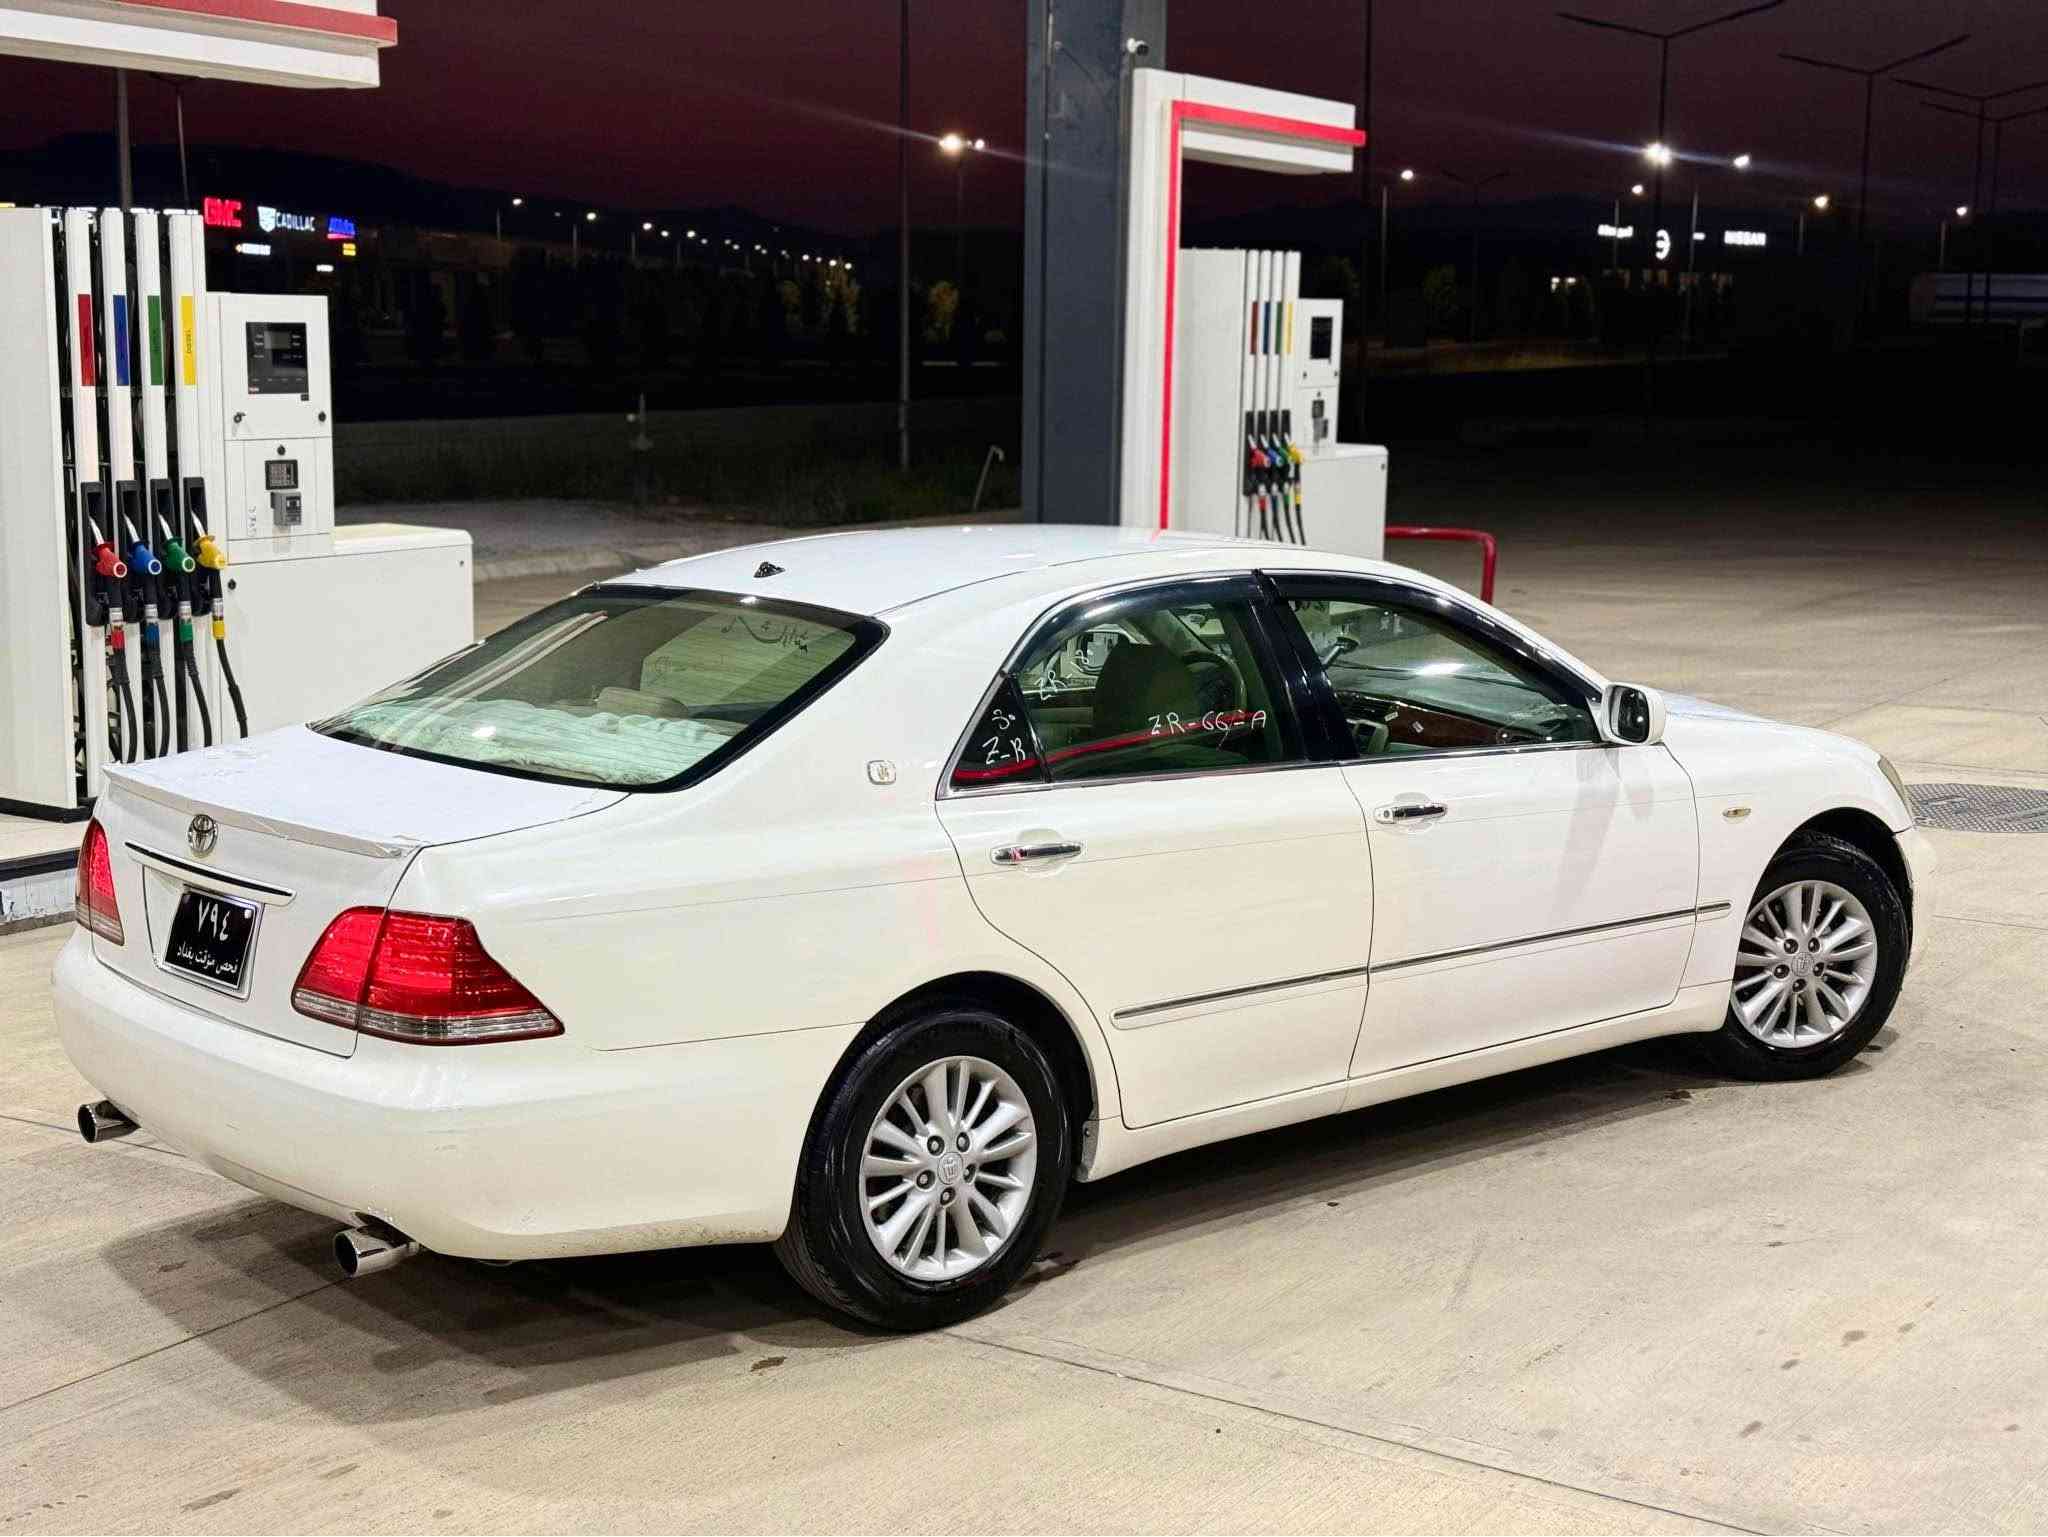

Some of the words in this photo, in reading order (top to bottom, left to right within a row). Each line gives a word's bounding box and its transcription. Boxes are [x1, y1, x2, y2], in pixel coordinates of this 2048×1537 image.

[204, 197, 242, 228] GMC
[275, 212, 316, 232] CADILLAC
[198, 899, 230, 941] ٧٩٤
[177, 941, 194, 964] بغداد
[215, 958, 239, 975] فحص
